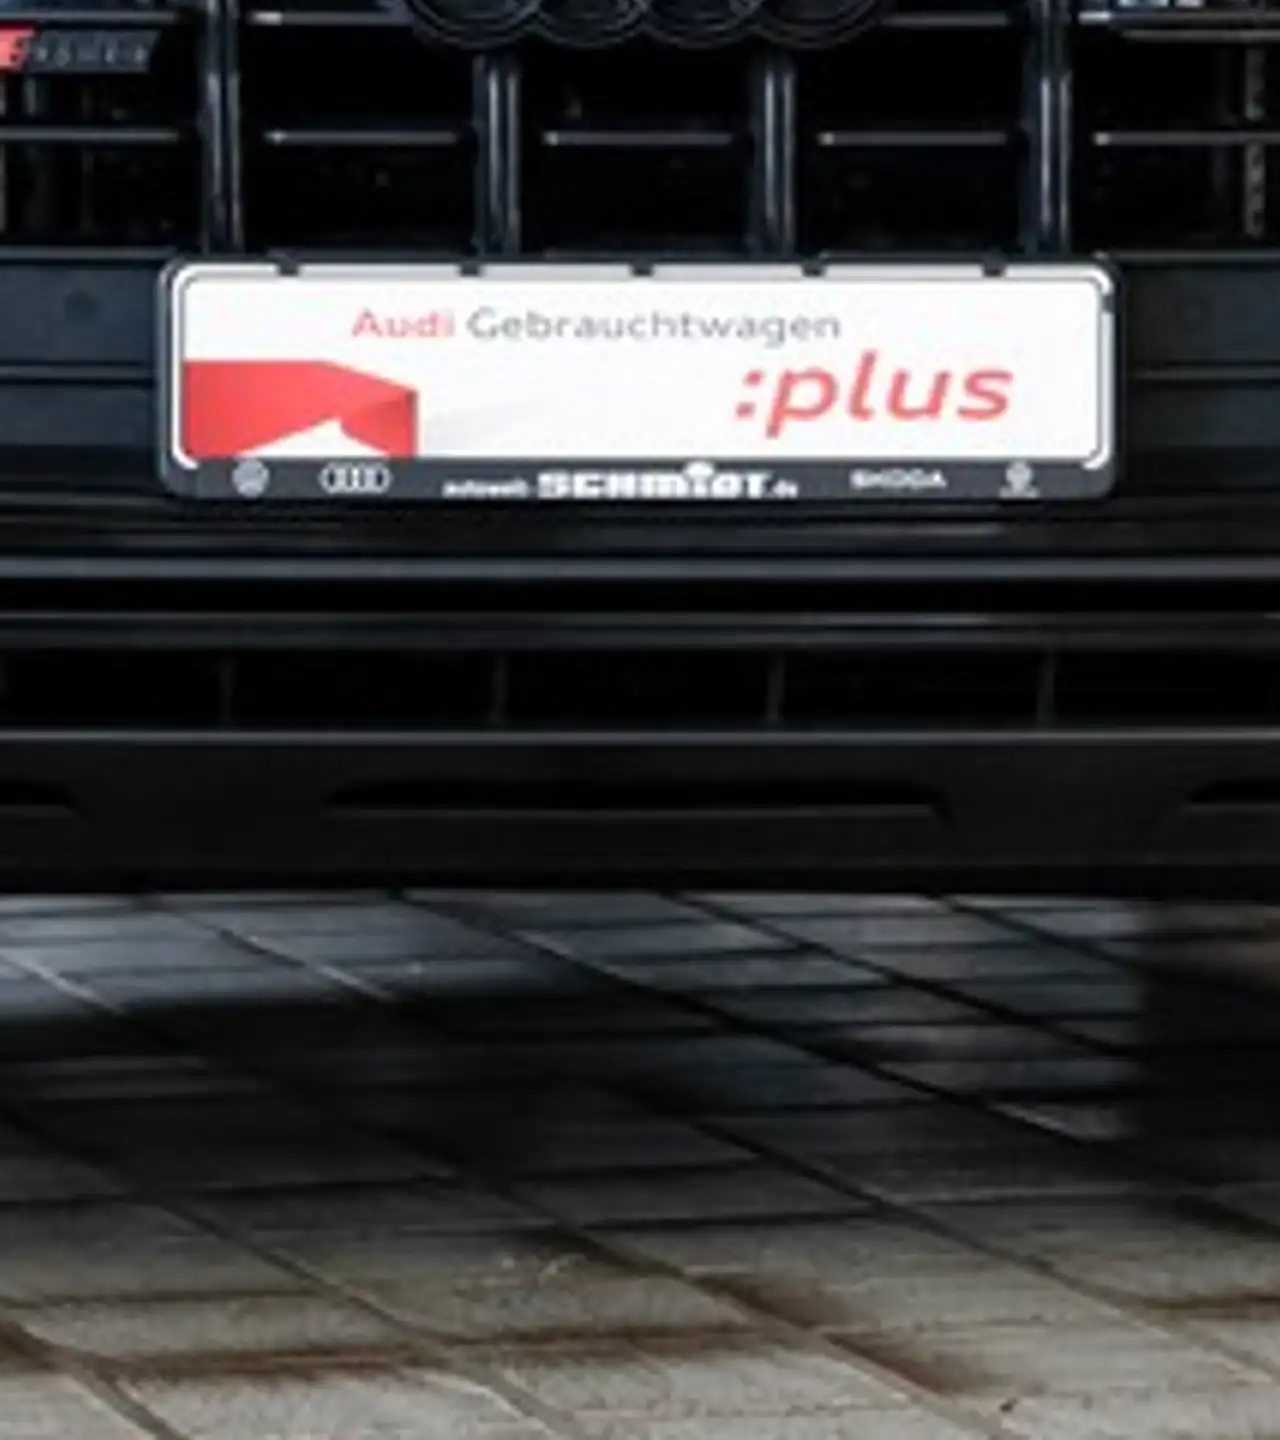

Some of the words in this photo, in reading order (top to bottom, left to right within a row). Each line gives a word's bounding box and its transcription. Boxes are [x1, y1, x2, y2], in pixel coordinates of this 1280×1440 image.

[351, 307, 455, 339] Audi
[465, 305, 843, 348] Gebrauchtwagen
[733, 347, 1015, 440] :plus
